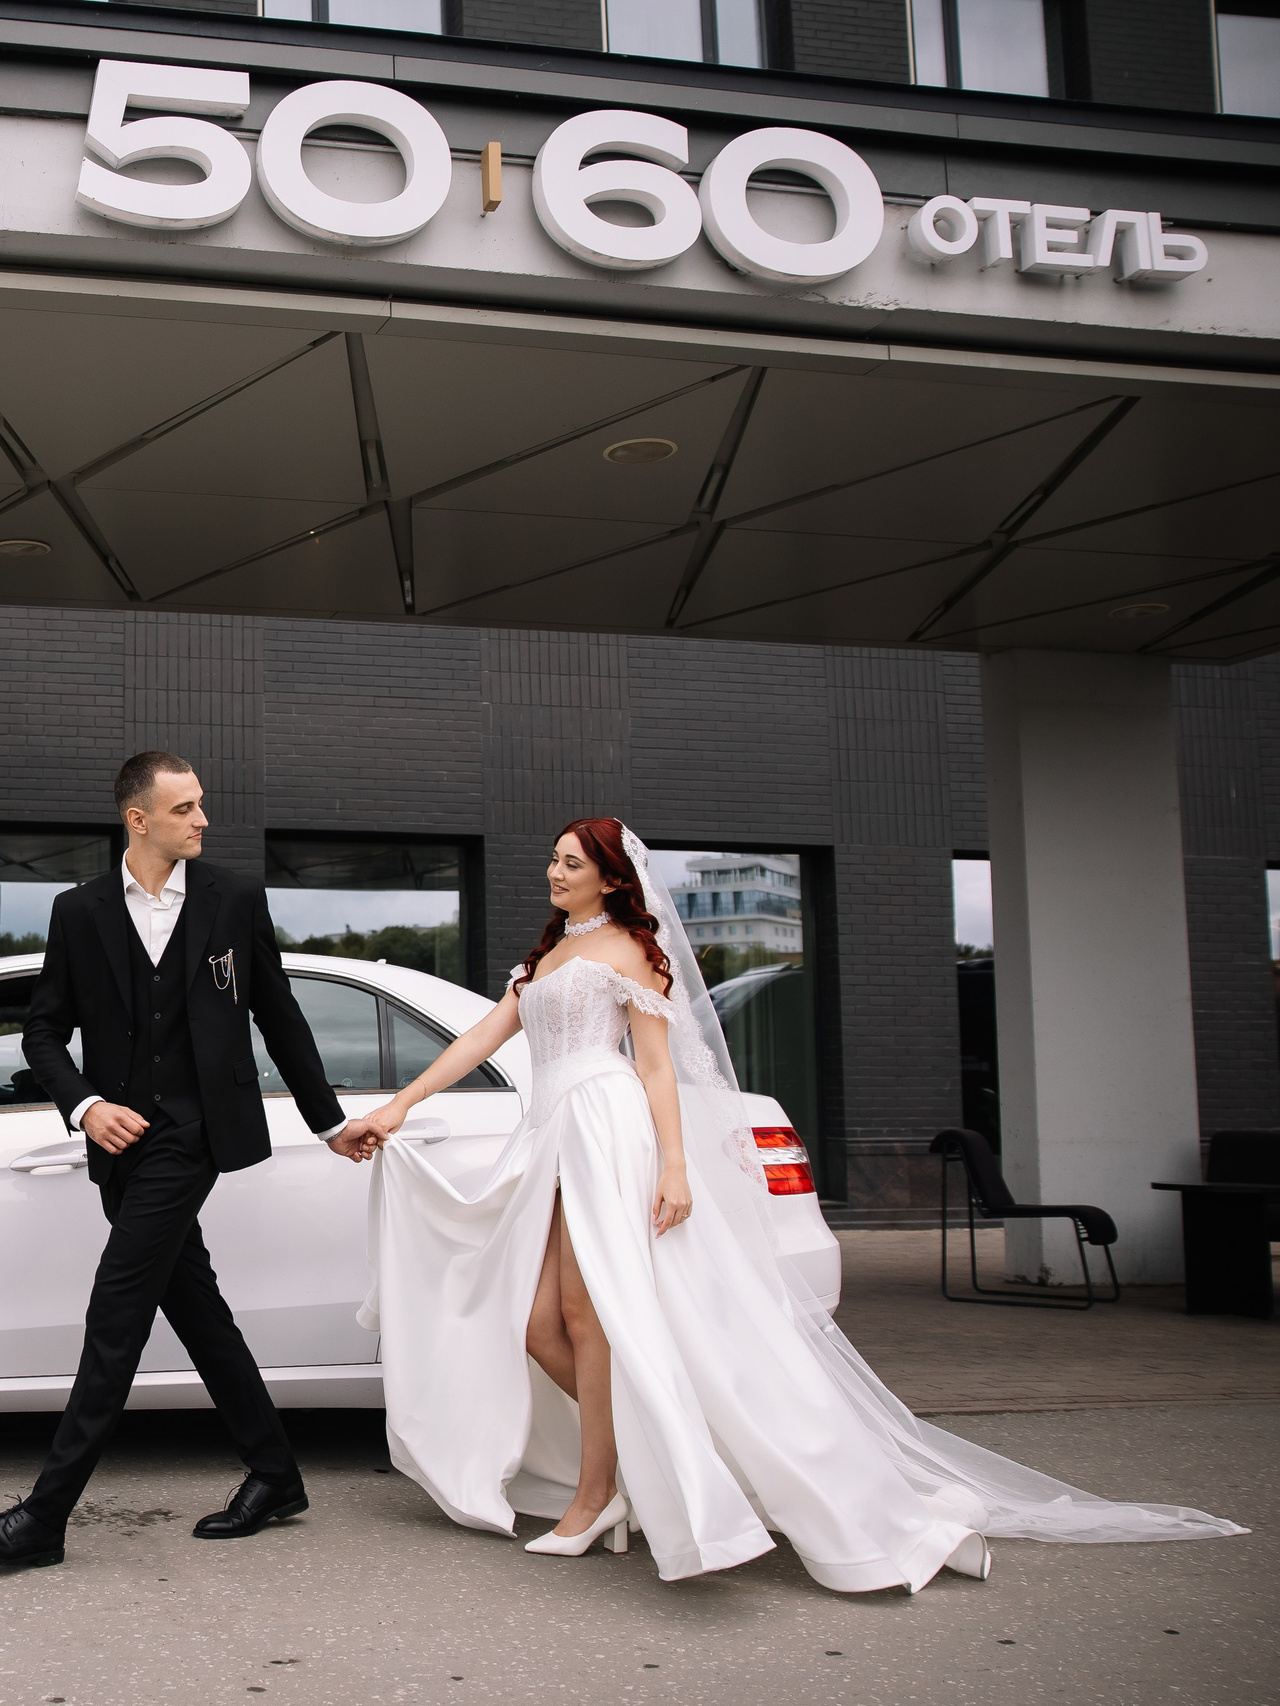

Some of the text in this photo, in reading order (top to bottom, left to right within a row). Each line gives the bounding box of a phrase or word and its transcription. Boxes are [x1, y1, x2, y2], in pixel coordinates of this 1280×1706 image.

[75, 59, 1209, 286] 50 60 ОТЕЛЬ
